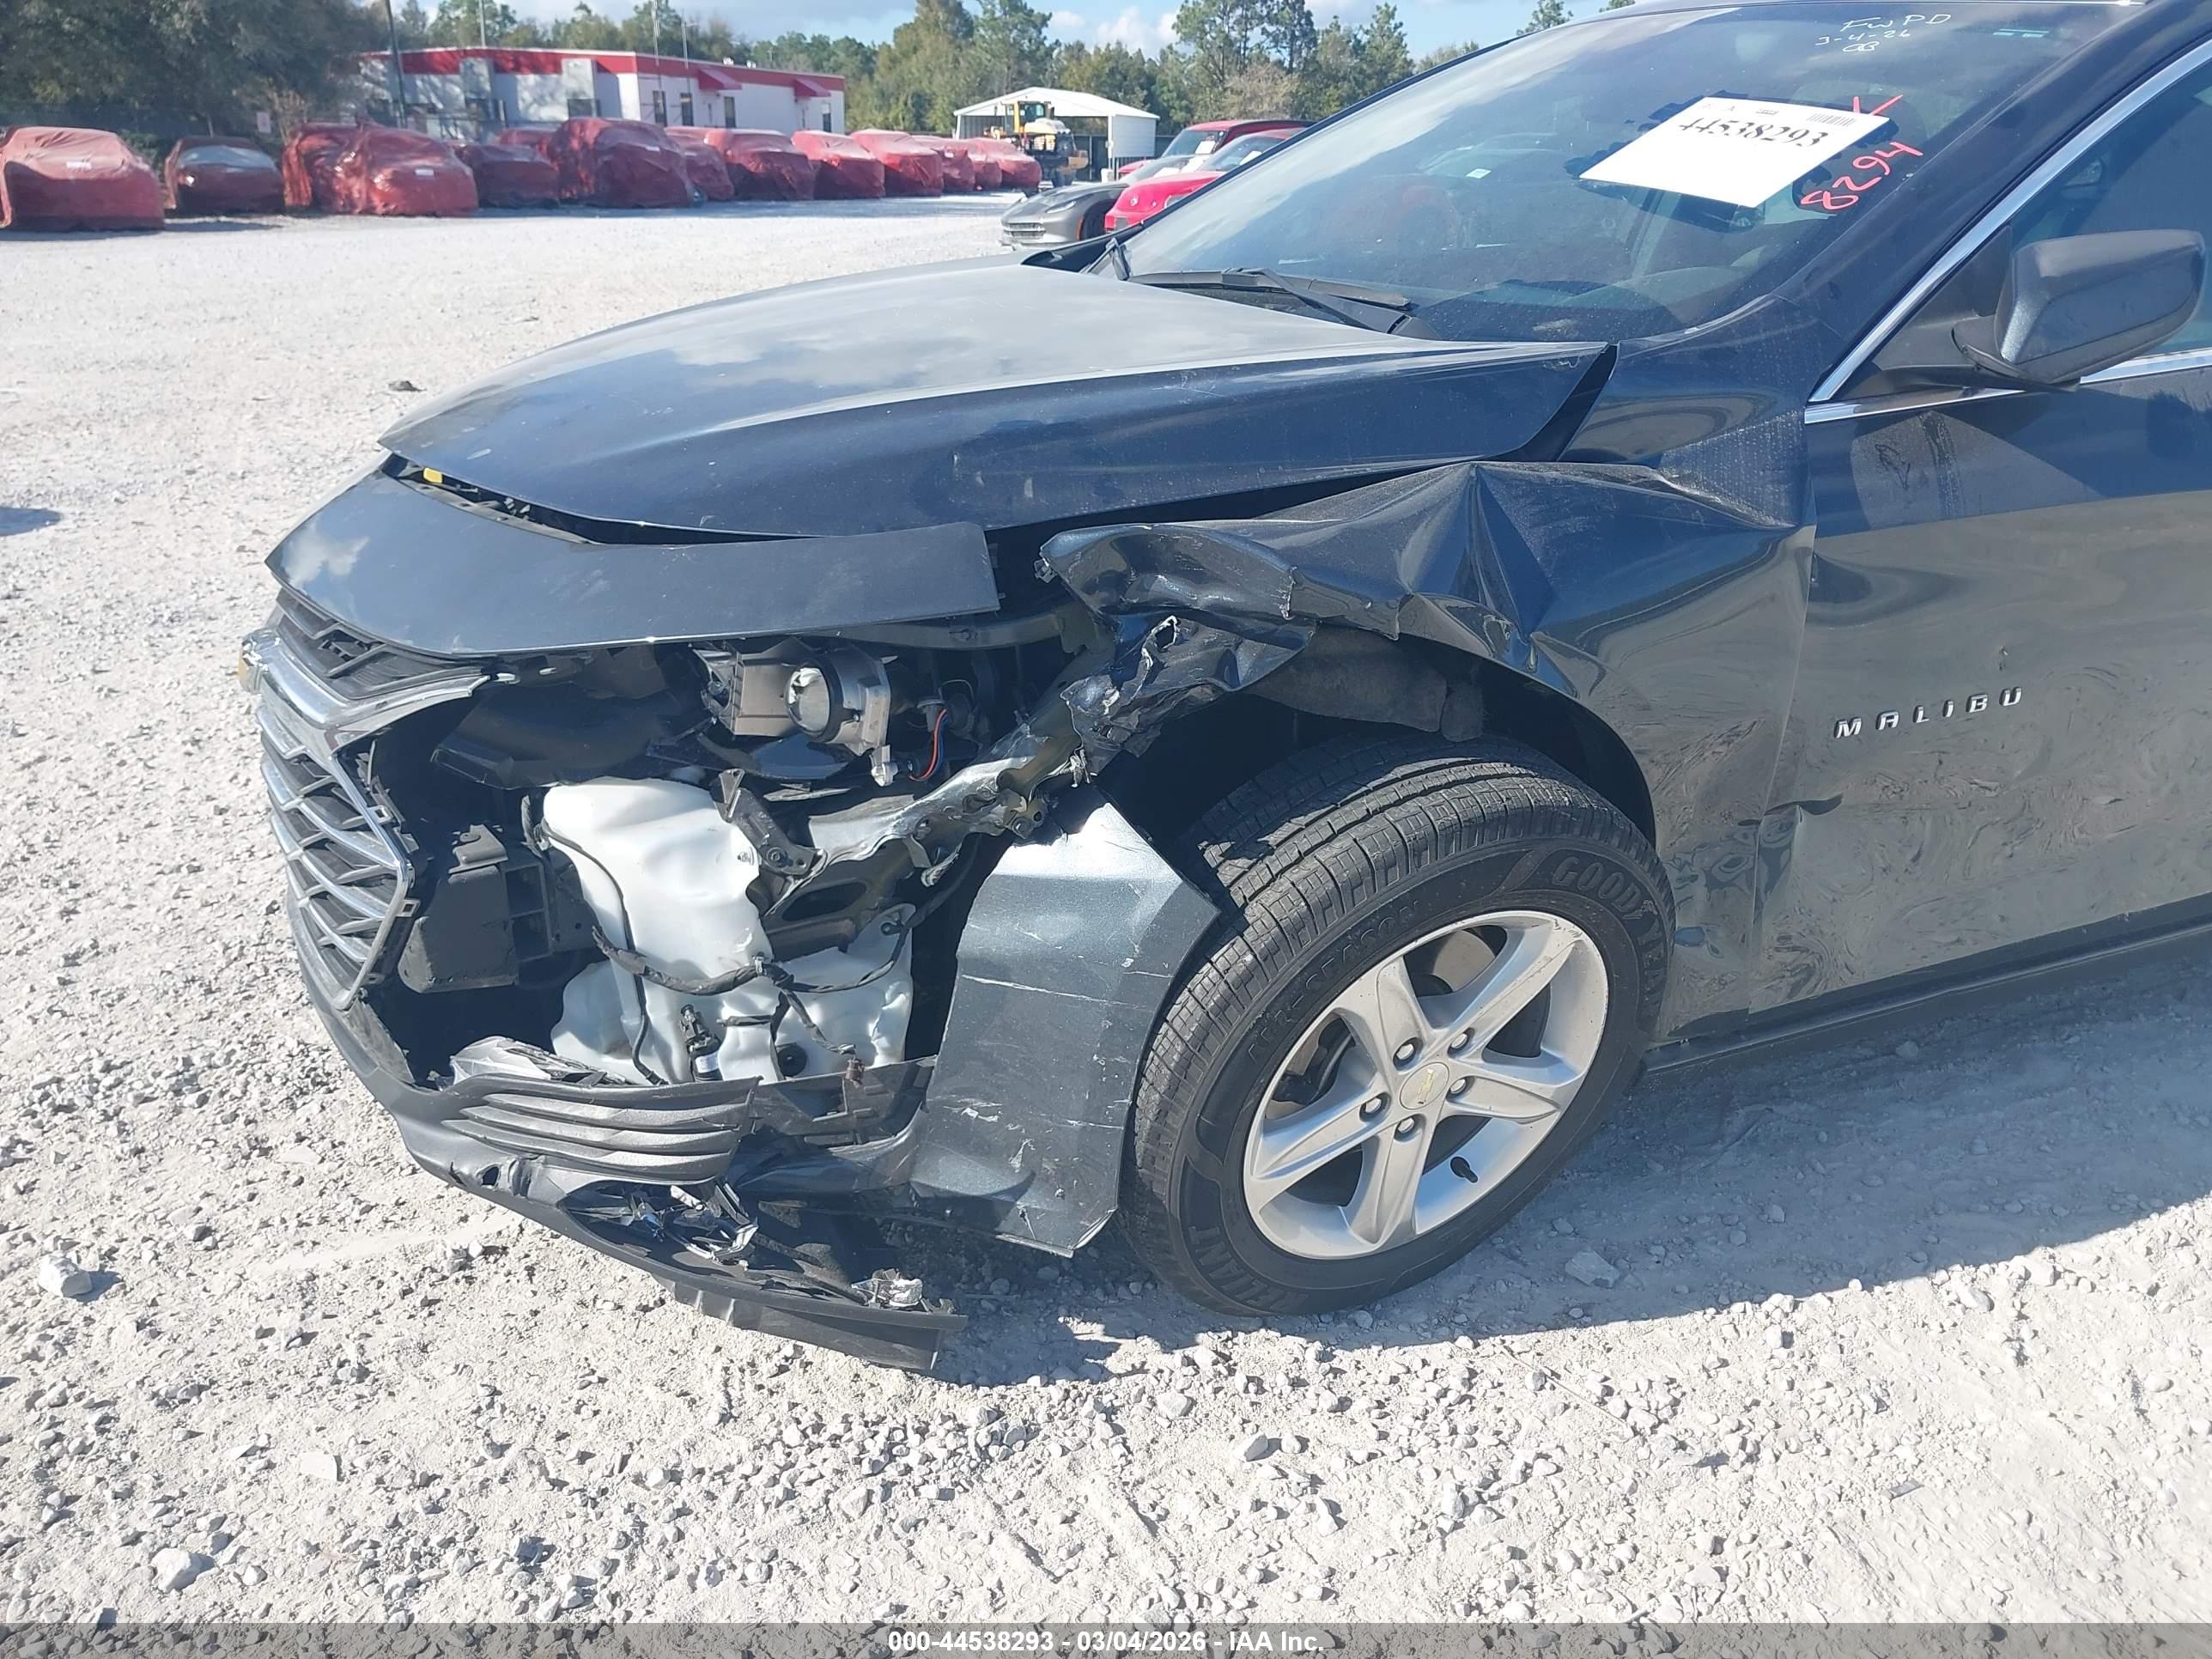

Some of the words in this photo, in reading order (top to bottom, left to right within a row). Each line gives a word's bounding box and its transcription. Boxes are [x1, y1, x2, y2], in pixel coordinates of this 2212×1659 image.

[1814, 28, 1911, 46] 3-4-26
[1679, 117, 1829, 147] 44538293
[1800, 141, 1924, 210] 8294
[1834, 686, 2022, 739] MALIBU
